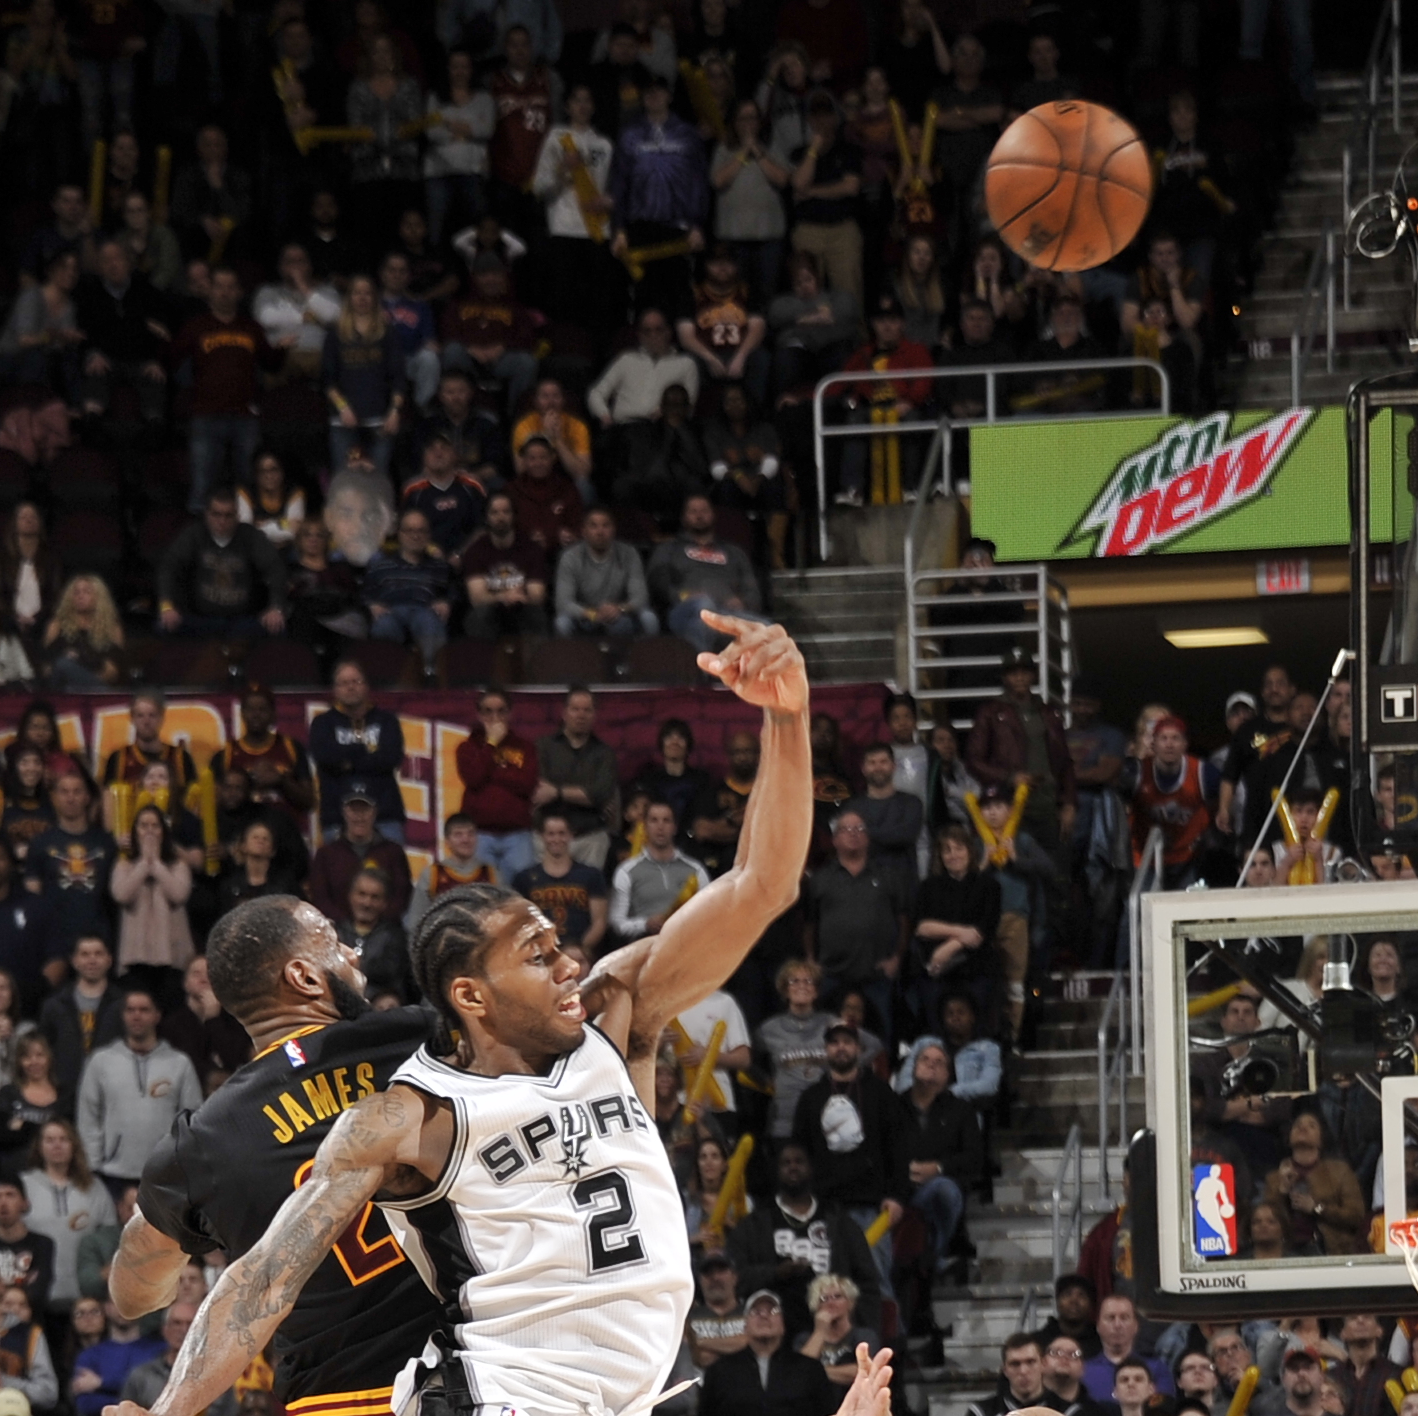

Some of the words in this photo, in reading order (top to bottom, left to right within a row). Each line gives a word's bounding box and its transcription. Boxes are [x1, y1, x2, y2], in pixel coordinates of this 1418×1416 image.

[262, 1062, 377, 1145] JAMES
[568, 1166, 650, 1277] 2
[1200, 1239, 1224, 1252] NBA
[1180, 1274, 1246, 1292] SPALDING
